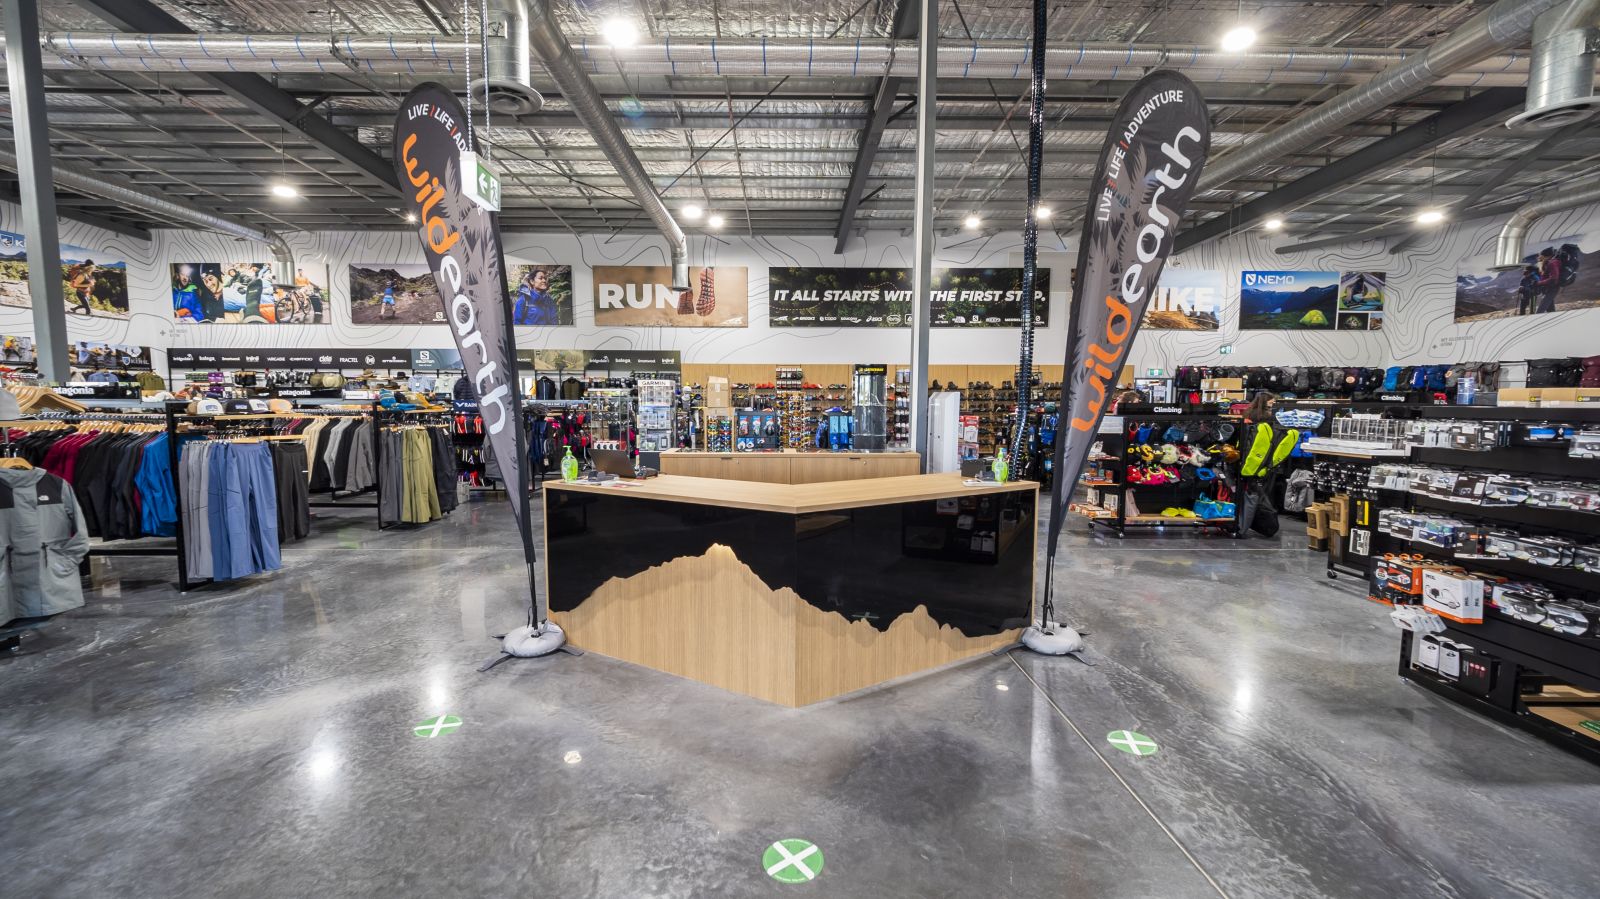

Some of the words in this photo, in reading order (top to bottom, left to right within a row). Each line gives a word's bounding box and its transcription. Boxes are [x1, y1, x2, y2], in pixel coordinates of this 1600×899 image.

[408, 103, 429, 120] LIVE
[434, 107, 454, 132] LIFE
[1097, 187, 1113, 222] LIVE
[1108, 147, 1127, 180] LIFE
[1124, 90, 1184, 144] ADVENTURE
[1258, 275, 1294, 285] NEMO
[598, 283, 680, 309] RUN
[774, 289, 789, 301] IT
[791, 289, 819, 301] ALL
[823, 289, 880, 302] STARTS
[884, 290, 913, 302] WIT
[930, 290, 957, 302] THE
[960, 290, 1003, 302] FIRST
[1004, 290, 1046, 302] STP.
[52, 386, 95, 396] atagonia
[278, 389, 311, 397] patagonia
[1381, 394, 1406, 402] Climbing
[1153, 406, 1182, 414] Climbing
